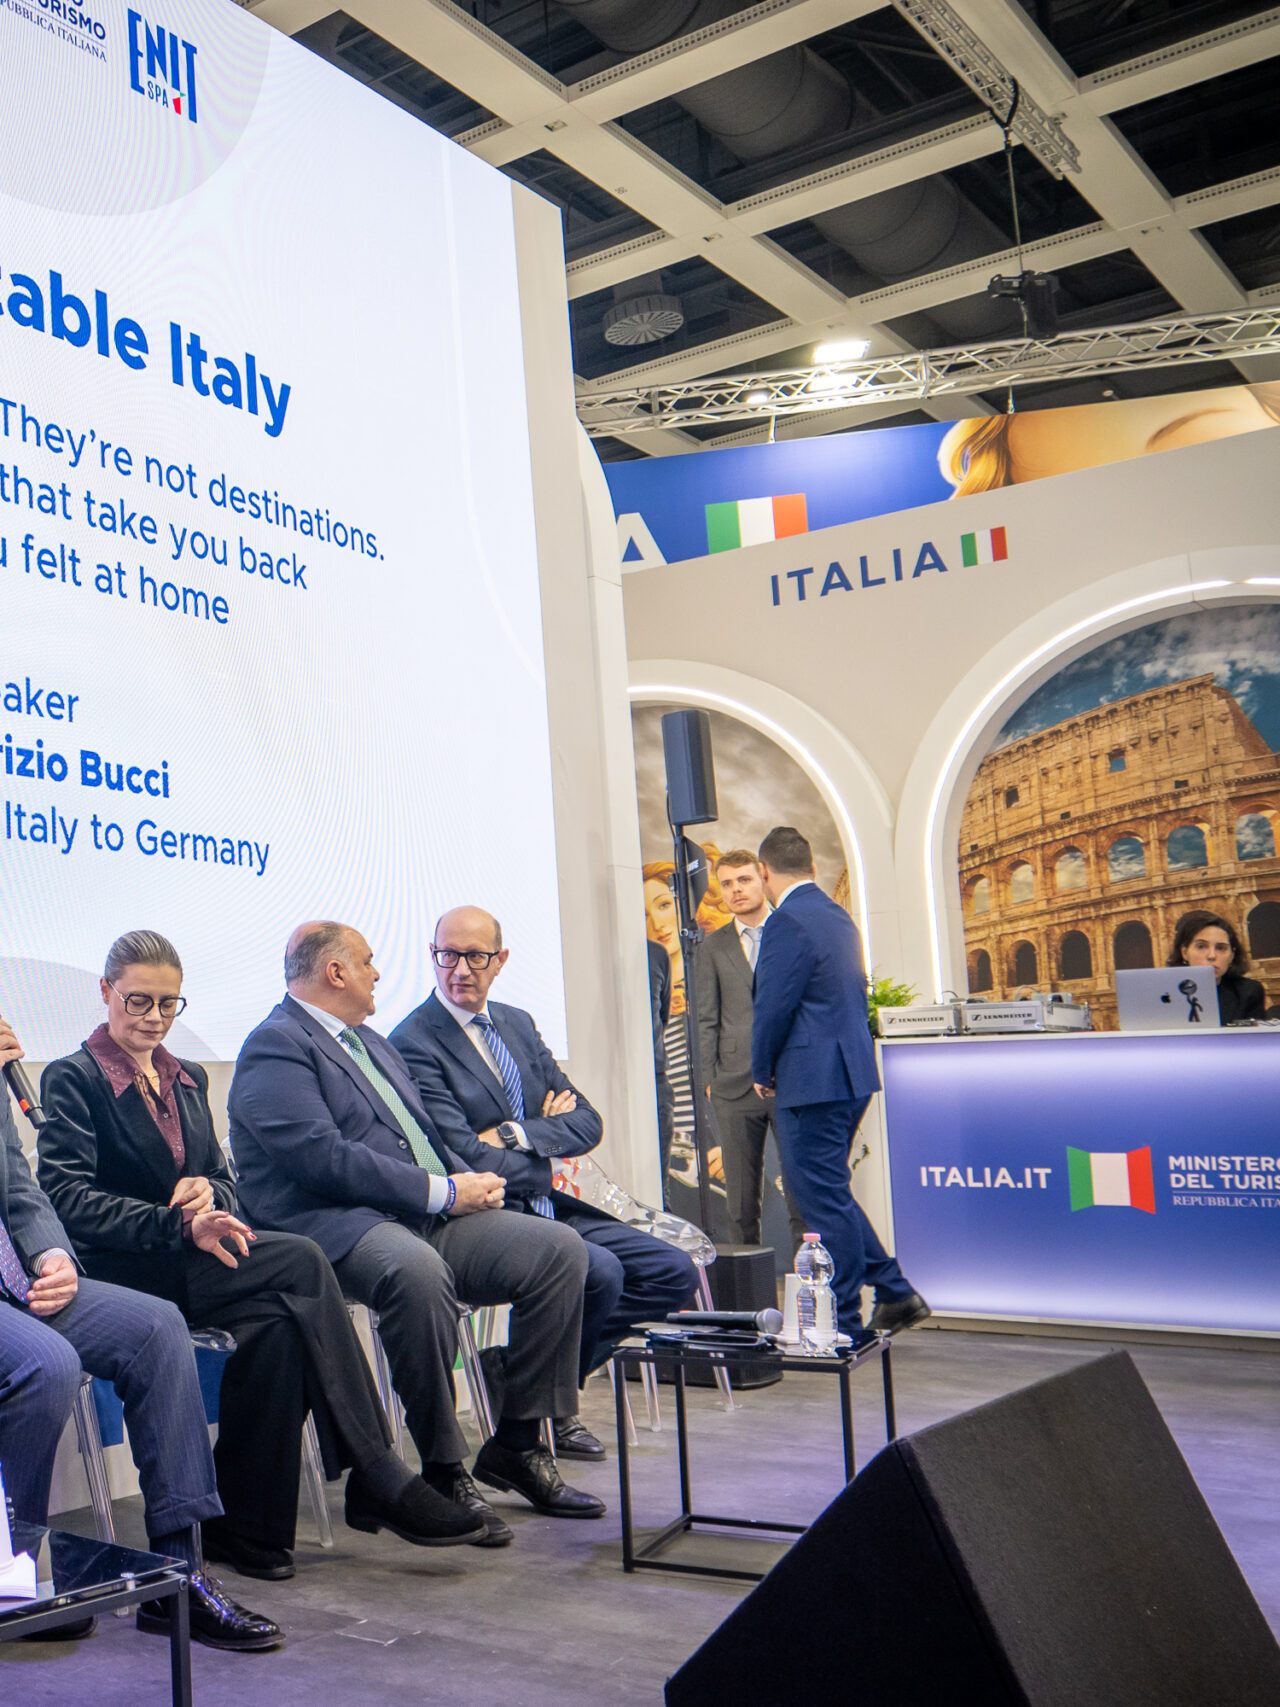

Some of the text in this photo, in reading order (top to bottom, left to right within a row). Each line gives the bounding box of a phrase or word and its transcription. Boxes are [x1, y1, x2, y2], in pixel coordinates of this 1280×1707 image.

[57, 26, 107, 63] ITALIANA
[127, 7, 198, 124] ENIT
[147, 80, 169, 109] SPA
[169, 321, 291, 438] Italy
[145, 455, 198, 499] not
[208, 473, 384, 561] destinations.
[83, 490, 158, 545] take
[168, 523, 228, 566] you
[239, 535, 307, 590] back
[21, 533, 82, 587] felt
[94, 561, 128, 599] at
[139, 565, 230, 625] home
[770, 541, 949, 607] ITALIA
[80, 749, 170, 799] Bucci
[5, 800, 79, 855] Italy
[89, 813, 125, 852] to
[135, 818, 270, 877] Germany
[920, 1166, 1053, 1189] ITALIA.IT
[1168, 1155, 1280, 1172] MINISTER
[1170, 1173, 1215, 1189] DEL
[1173, 1195, 1259, 1208] REPUBBLICA
